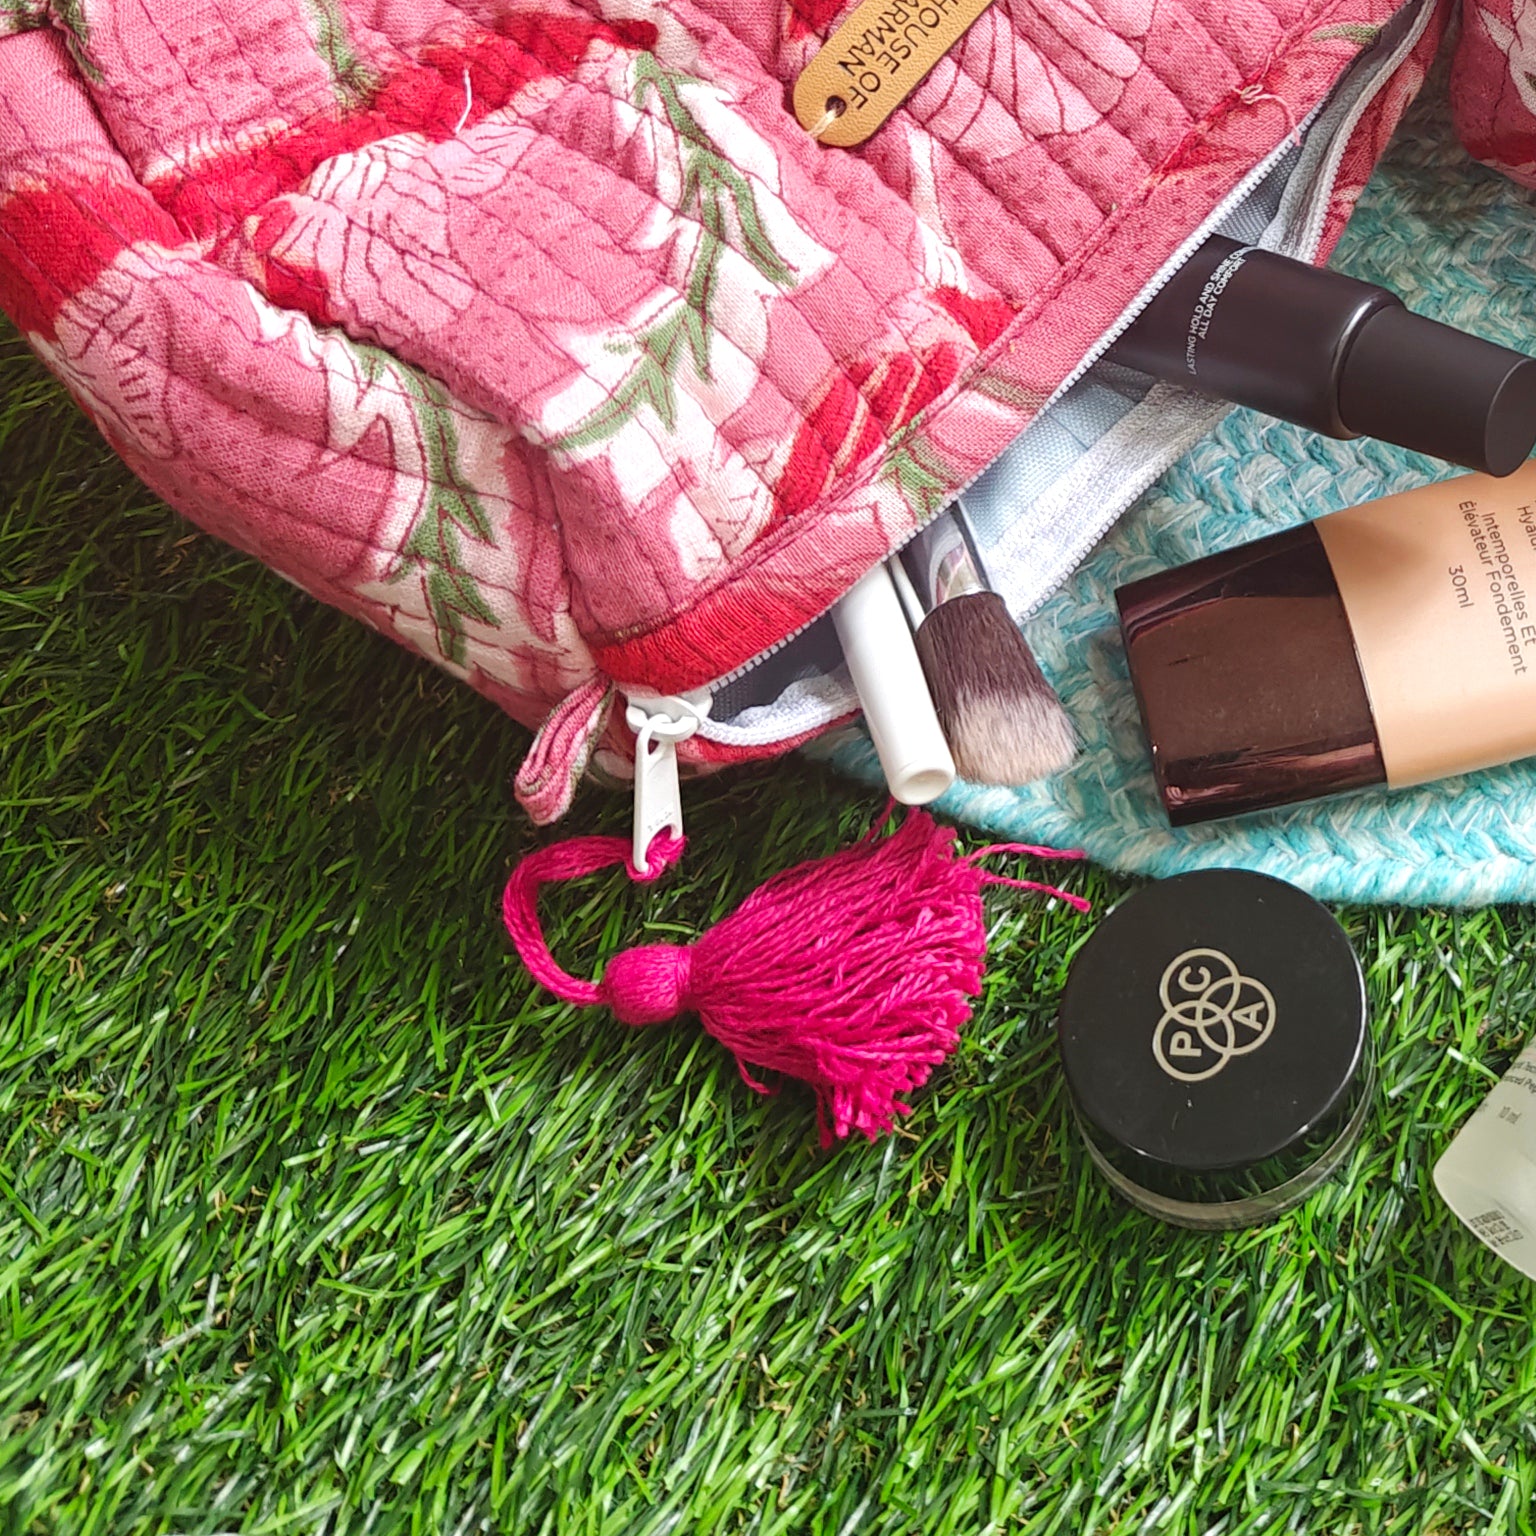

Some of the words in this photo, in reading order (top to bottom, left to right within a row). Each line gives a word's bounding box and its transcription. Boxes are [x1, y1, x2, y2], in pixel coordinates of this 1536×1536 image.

[850, 70, 881, 110] OF
[1210, 257, 1233, 282] SHINE
[1213, 255, 1248, 295] COMFORT
[1199, 281, 1216, 306] AND
[1202, 294, 1218, 319] DAY
[1189, 304, 1205, 335] HOLD
[1198, 320, 1211, 340] ALL
[1185, 335, 1198, 376] LASTING
[1448, 564, 1475, 609] 30ml
[1481, 512, 1529, 621] Intemporelles
[1458, 500, 1494, 567] Élévateur
[1485, 569, 1528, 676] Fondement
